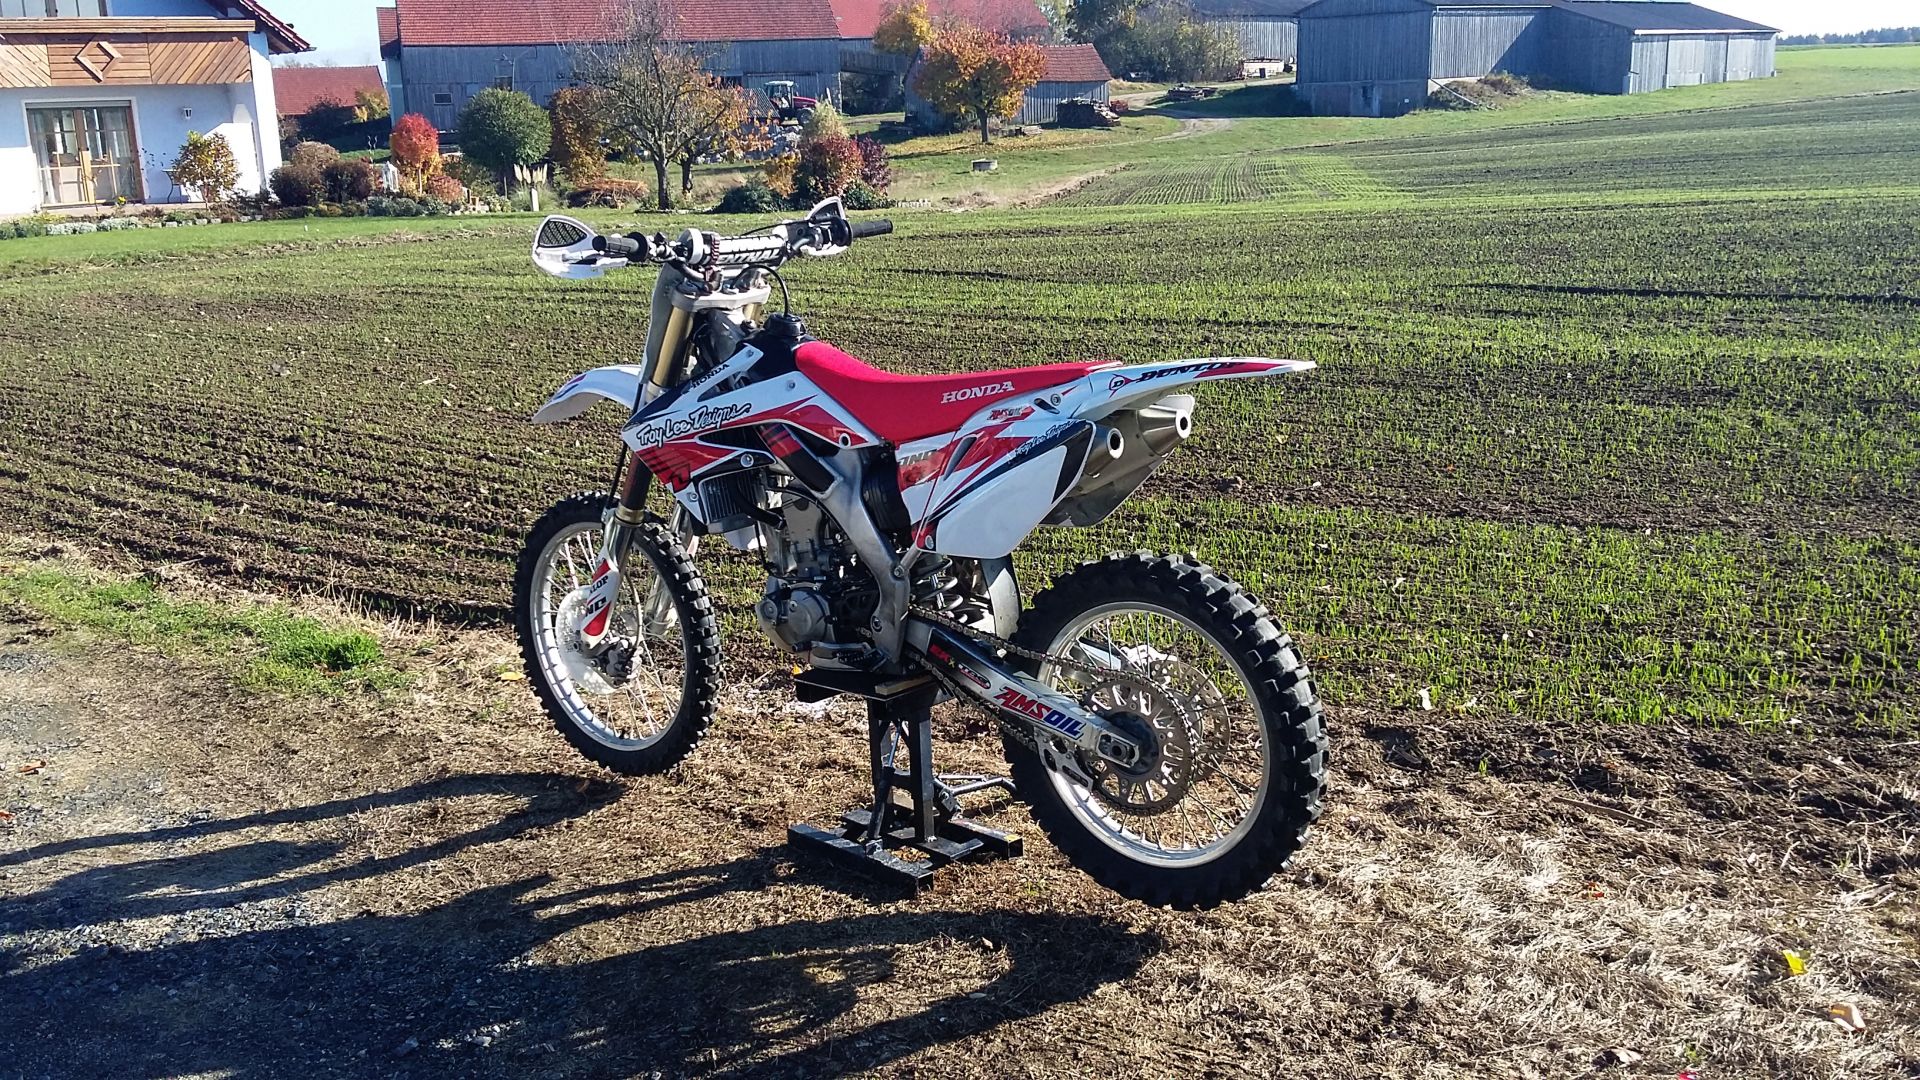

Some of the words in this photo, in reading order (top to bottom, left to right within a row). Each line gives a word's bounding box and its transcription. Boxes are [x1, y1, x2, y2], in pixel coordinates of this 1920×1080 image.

[690, 363, 730, 388] HONDA
[941, 381, 1015, 404] HONDA
[636, 424, 663, 448] Troy
[665, 418, 692, 439] Lee
[689, 403, 752, 429] Designs
[994, 685, 1086, 740] AMSOIL
